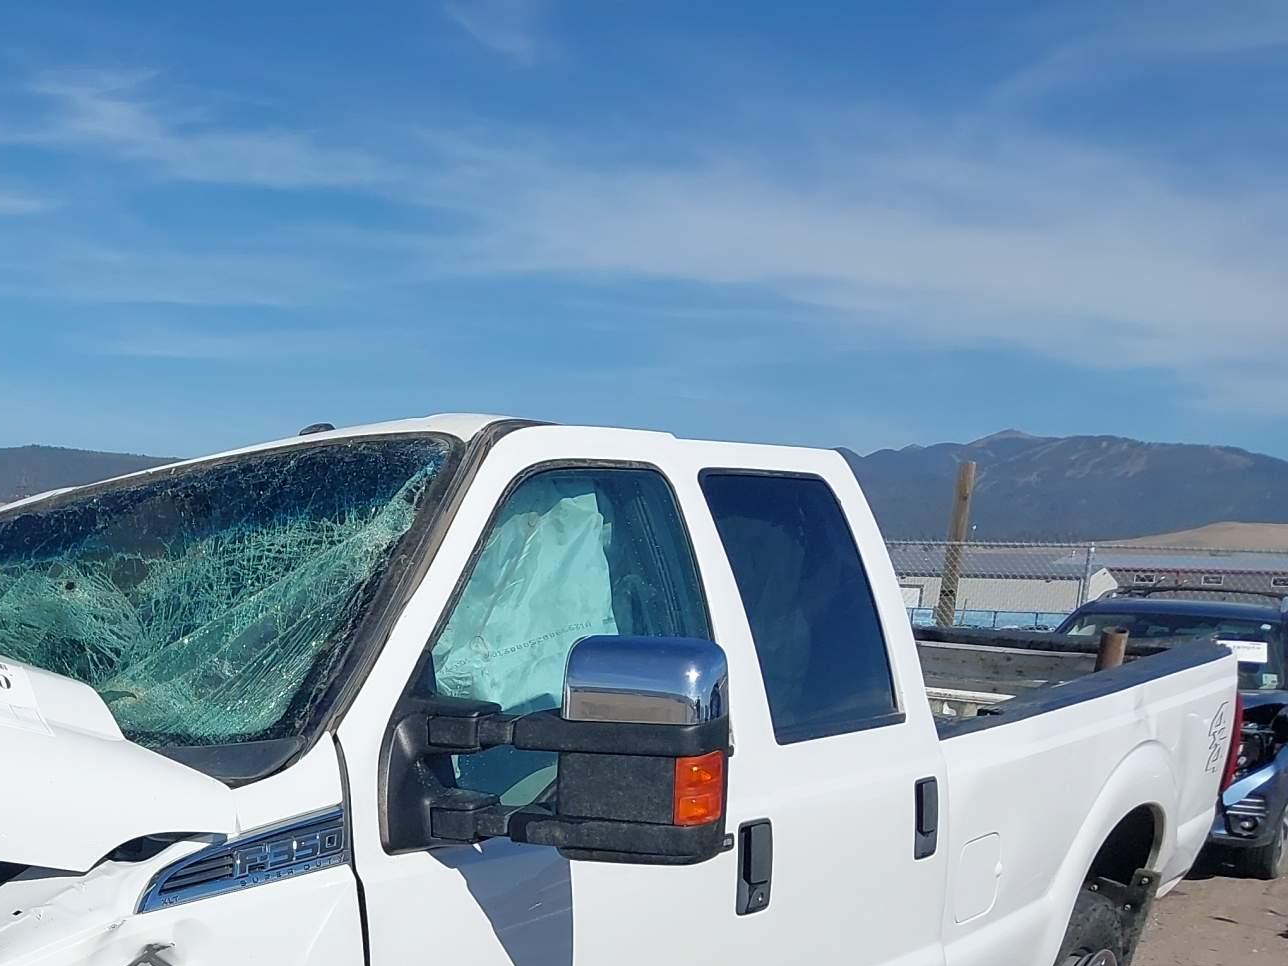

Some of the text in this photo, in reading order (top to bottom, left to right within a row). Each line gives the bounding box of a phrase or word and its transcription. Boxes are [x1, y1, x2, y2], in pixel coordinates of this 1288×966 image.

[239, 853, 346, 887] SUPER DUTY
[161, 896, 179, 906] XLT
